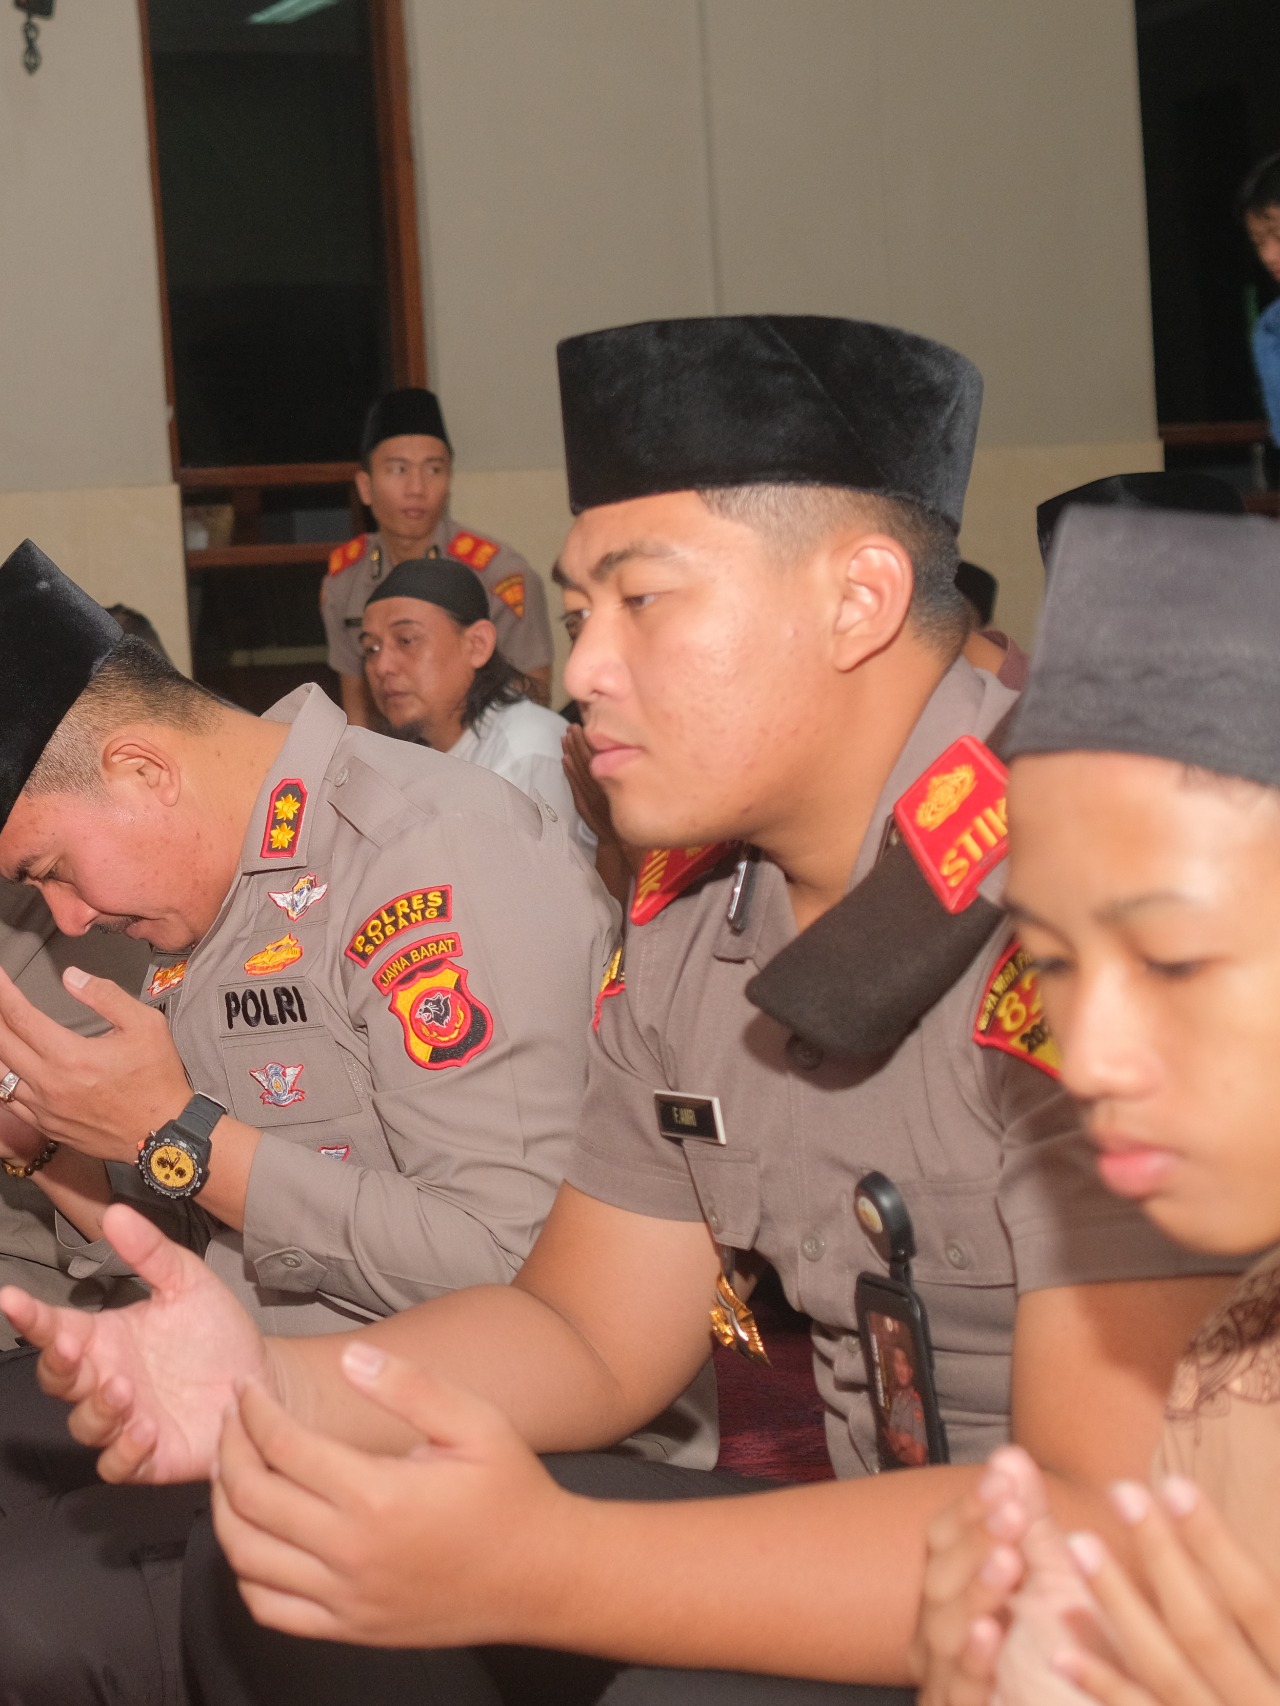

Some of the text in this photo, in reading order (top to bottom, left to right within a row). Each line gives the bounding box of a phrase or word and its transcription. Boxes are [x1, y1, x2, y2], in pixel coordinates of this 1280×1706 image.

[353, 890, 444, 953] POLRES
[364, 907, 439, 956] SUBANG
[379, 939, 456, 988] JAWA BARAT
[224, 985, 308, 1030] POLRI
